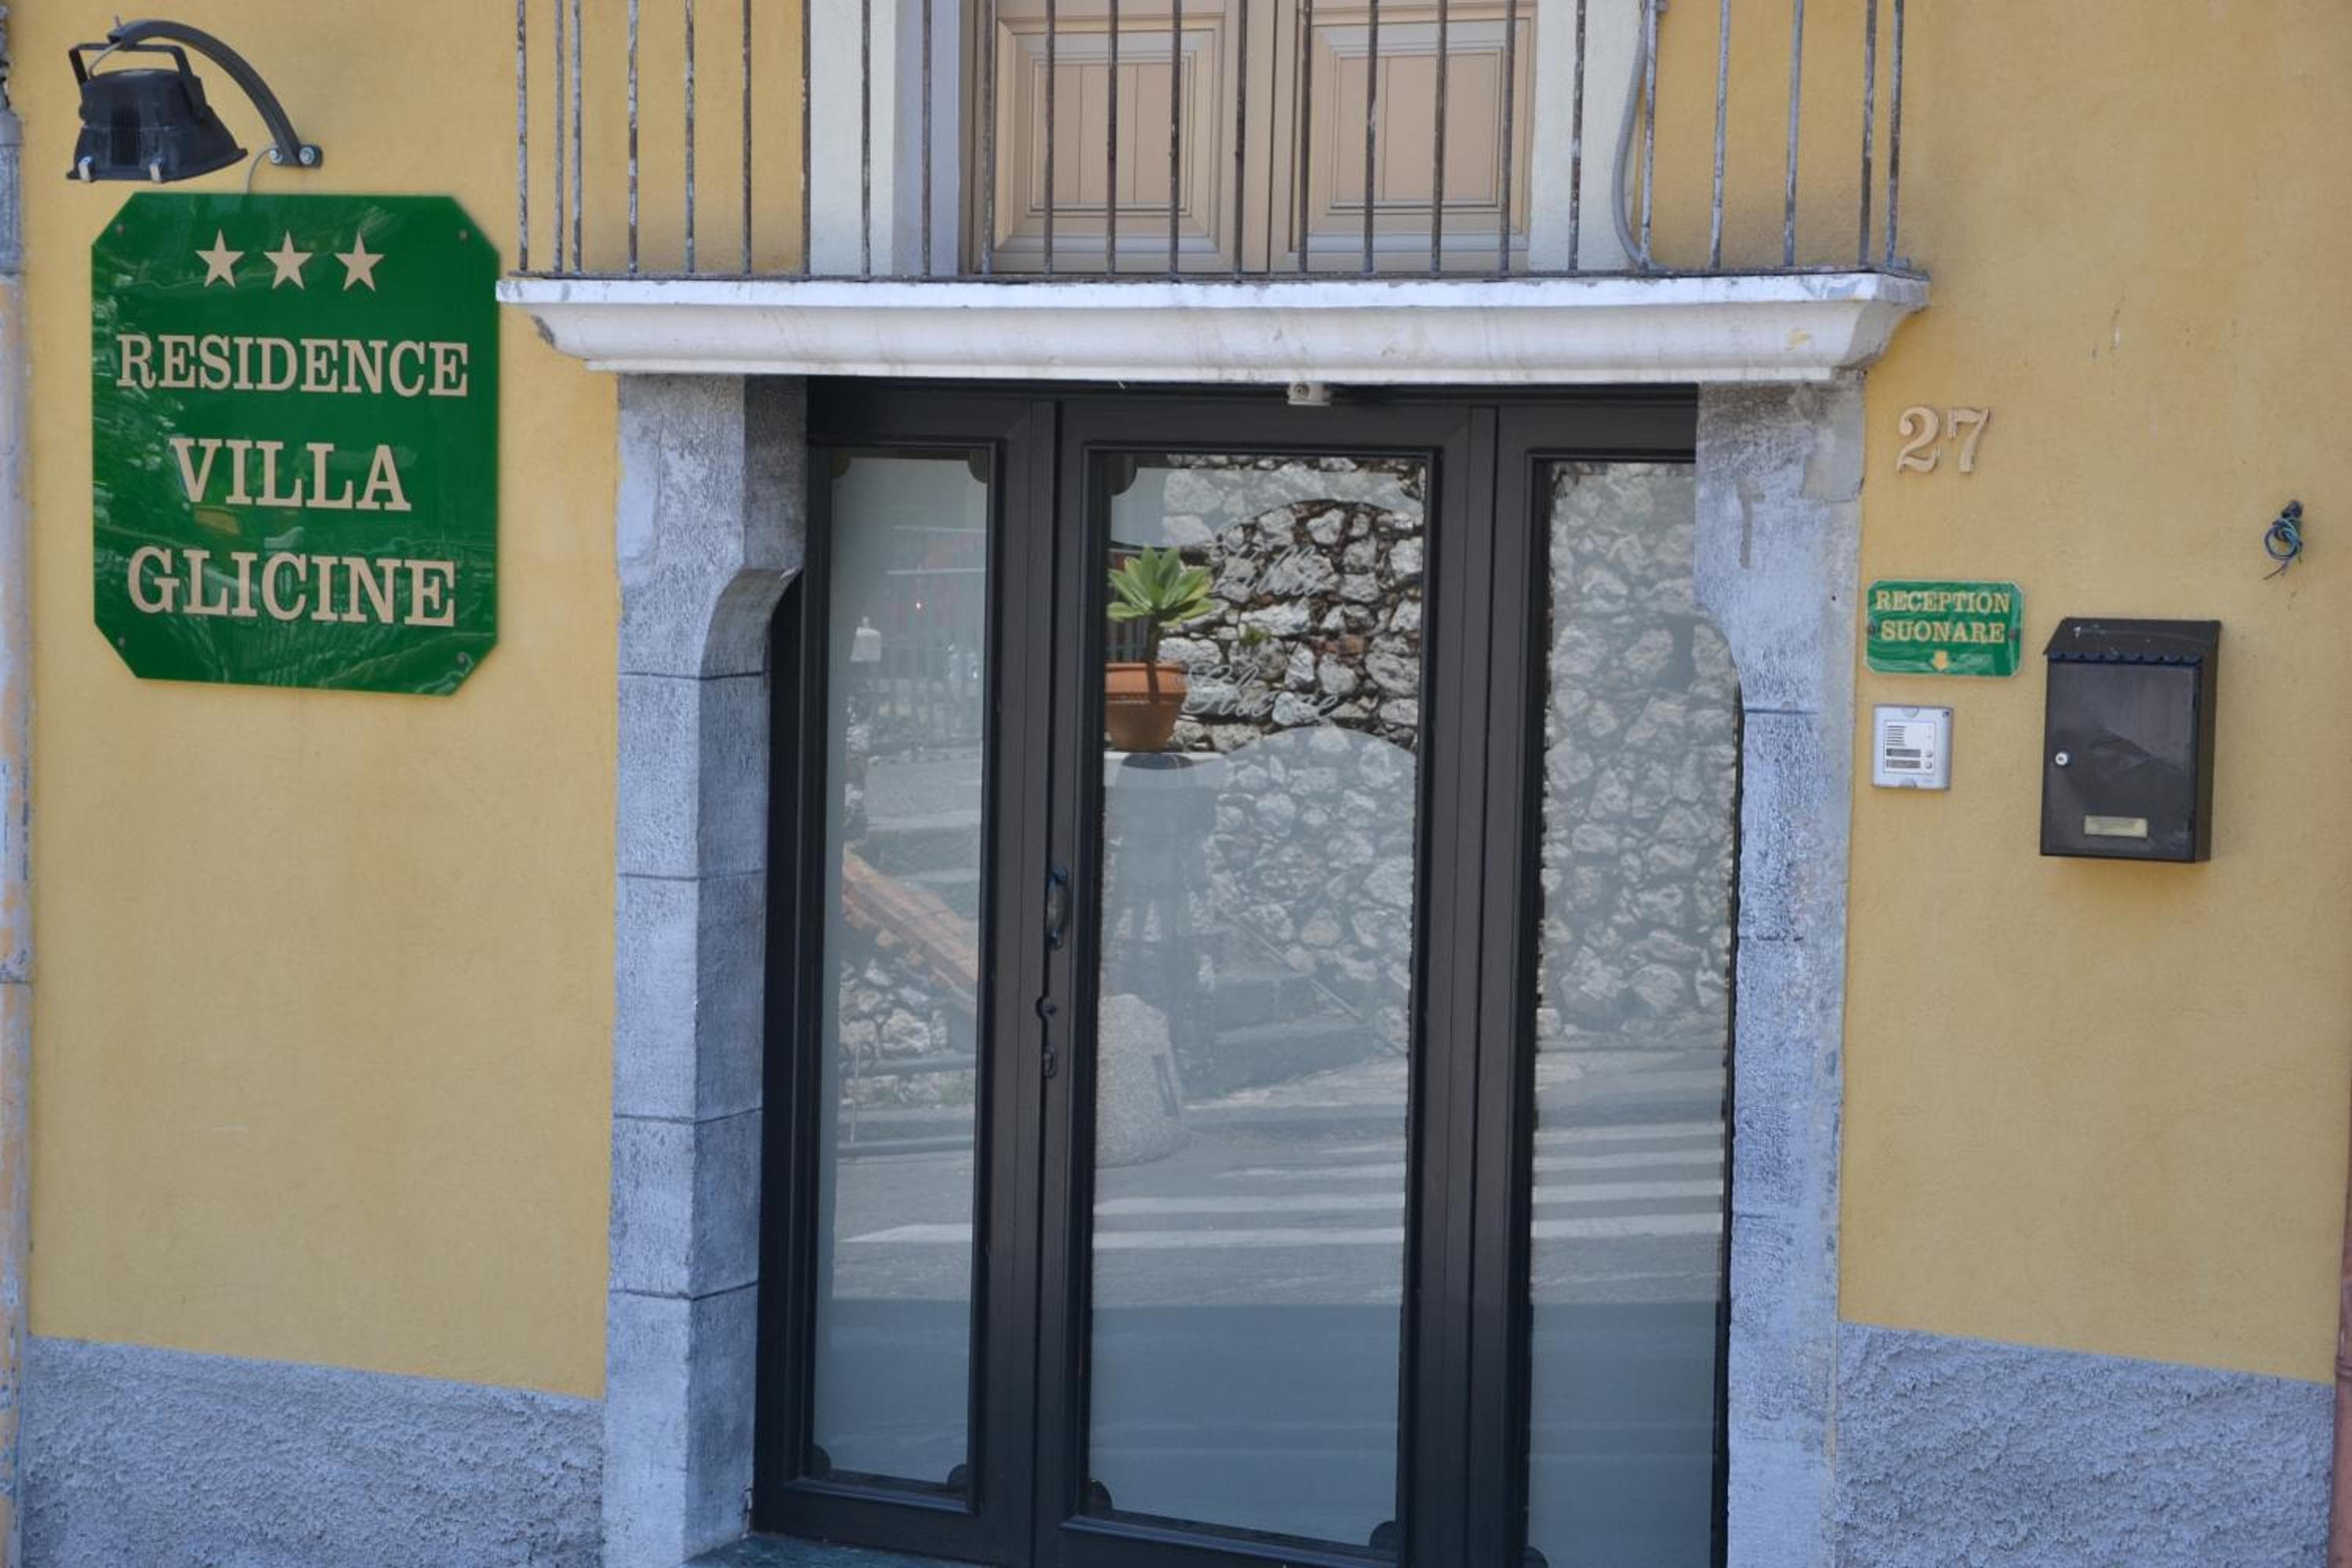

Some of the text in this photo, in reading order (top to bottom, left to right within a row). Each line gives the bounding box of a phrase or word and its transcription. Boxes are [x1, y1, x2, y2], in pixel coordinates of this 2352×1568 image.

[116, 334, 468, 397] RESIDENCE
[1897, 407, 1991, 472] 27
[169, 438, 411, 511] VILLA
[127, 546, 455, 626] GLICINE
[1876, 590, 2011, 615] RECEPTION
[1882, 619, 2005, 644] SUONARE
